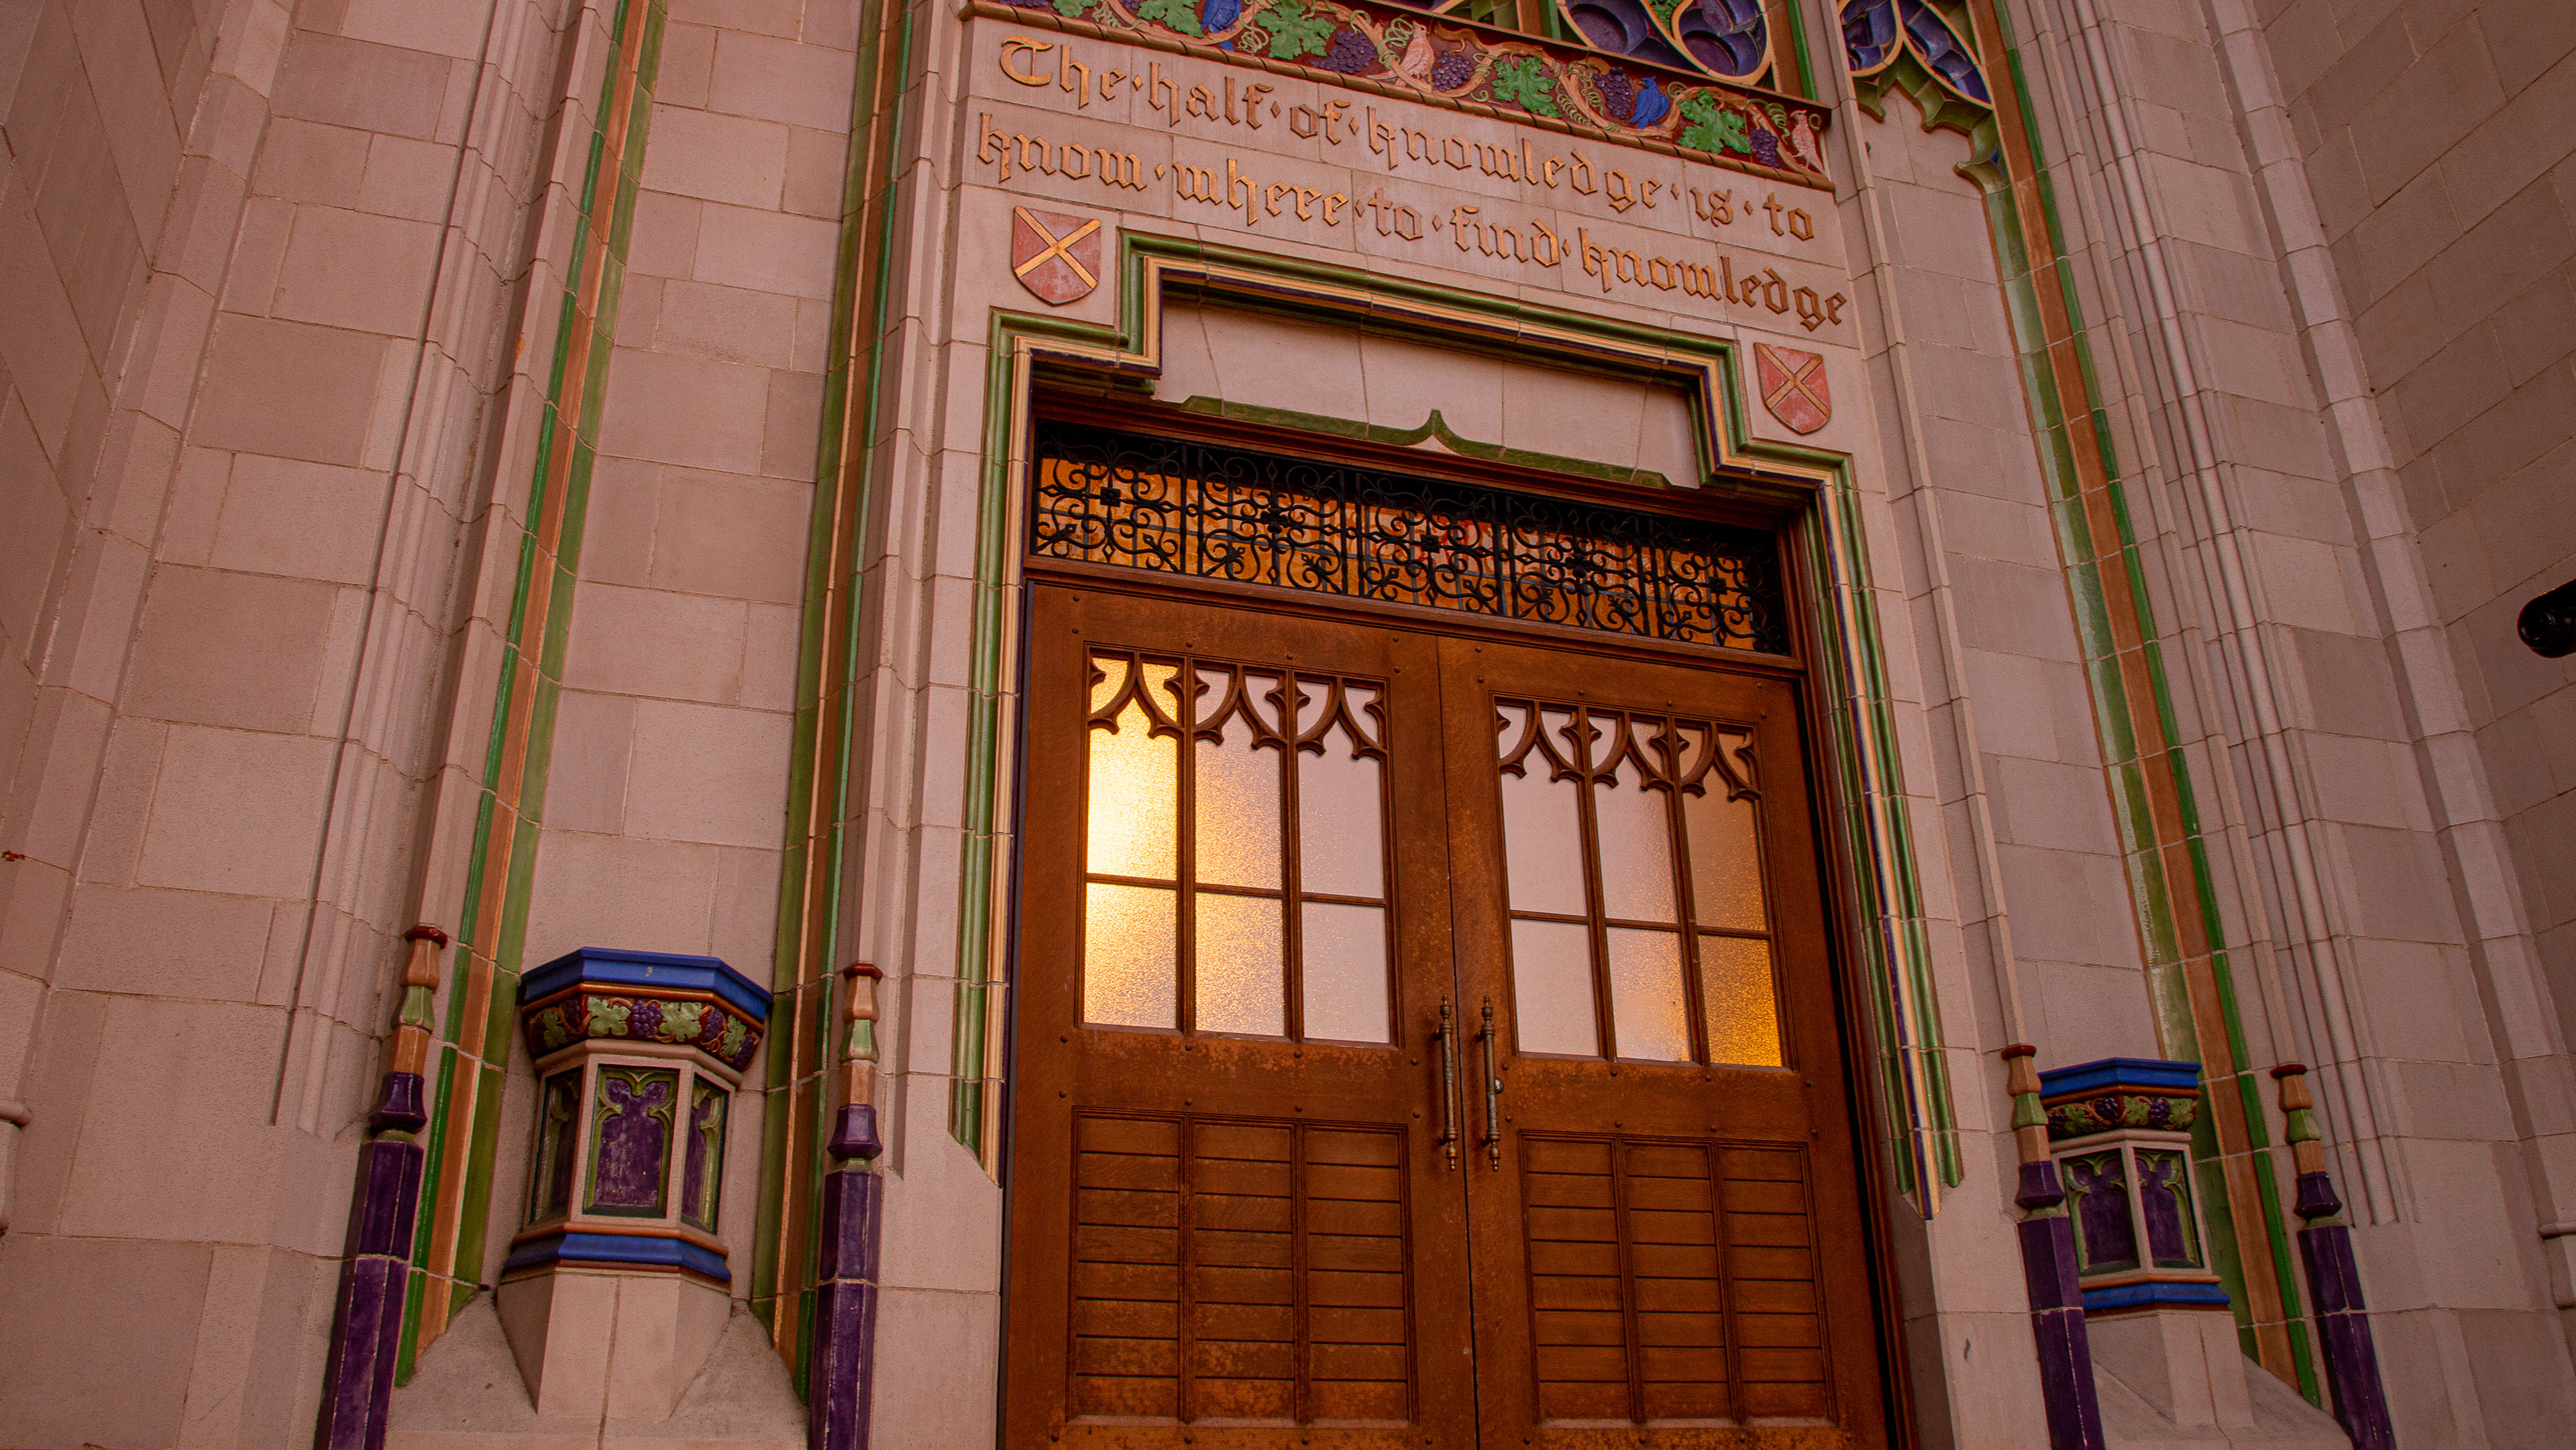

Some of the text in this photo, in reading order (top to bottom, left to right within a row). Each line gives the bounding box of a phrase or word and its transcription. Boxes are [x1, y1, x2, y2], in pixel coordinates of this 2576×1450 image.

[977, 111, 1847, 332] know where to find knowledge
[1000, 36, 1815, 241] The half of knowledge is to
